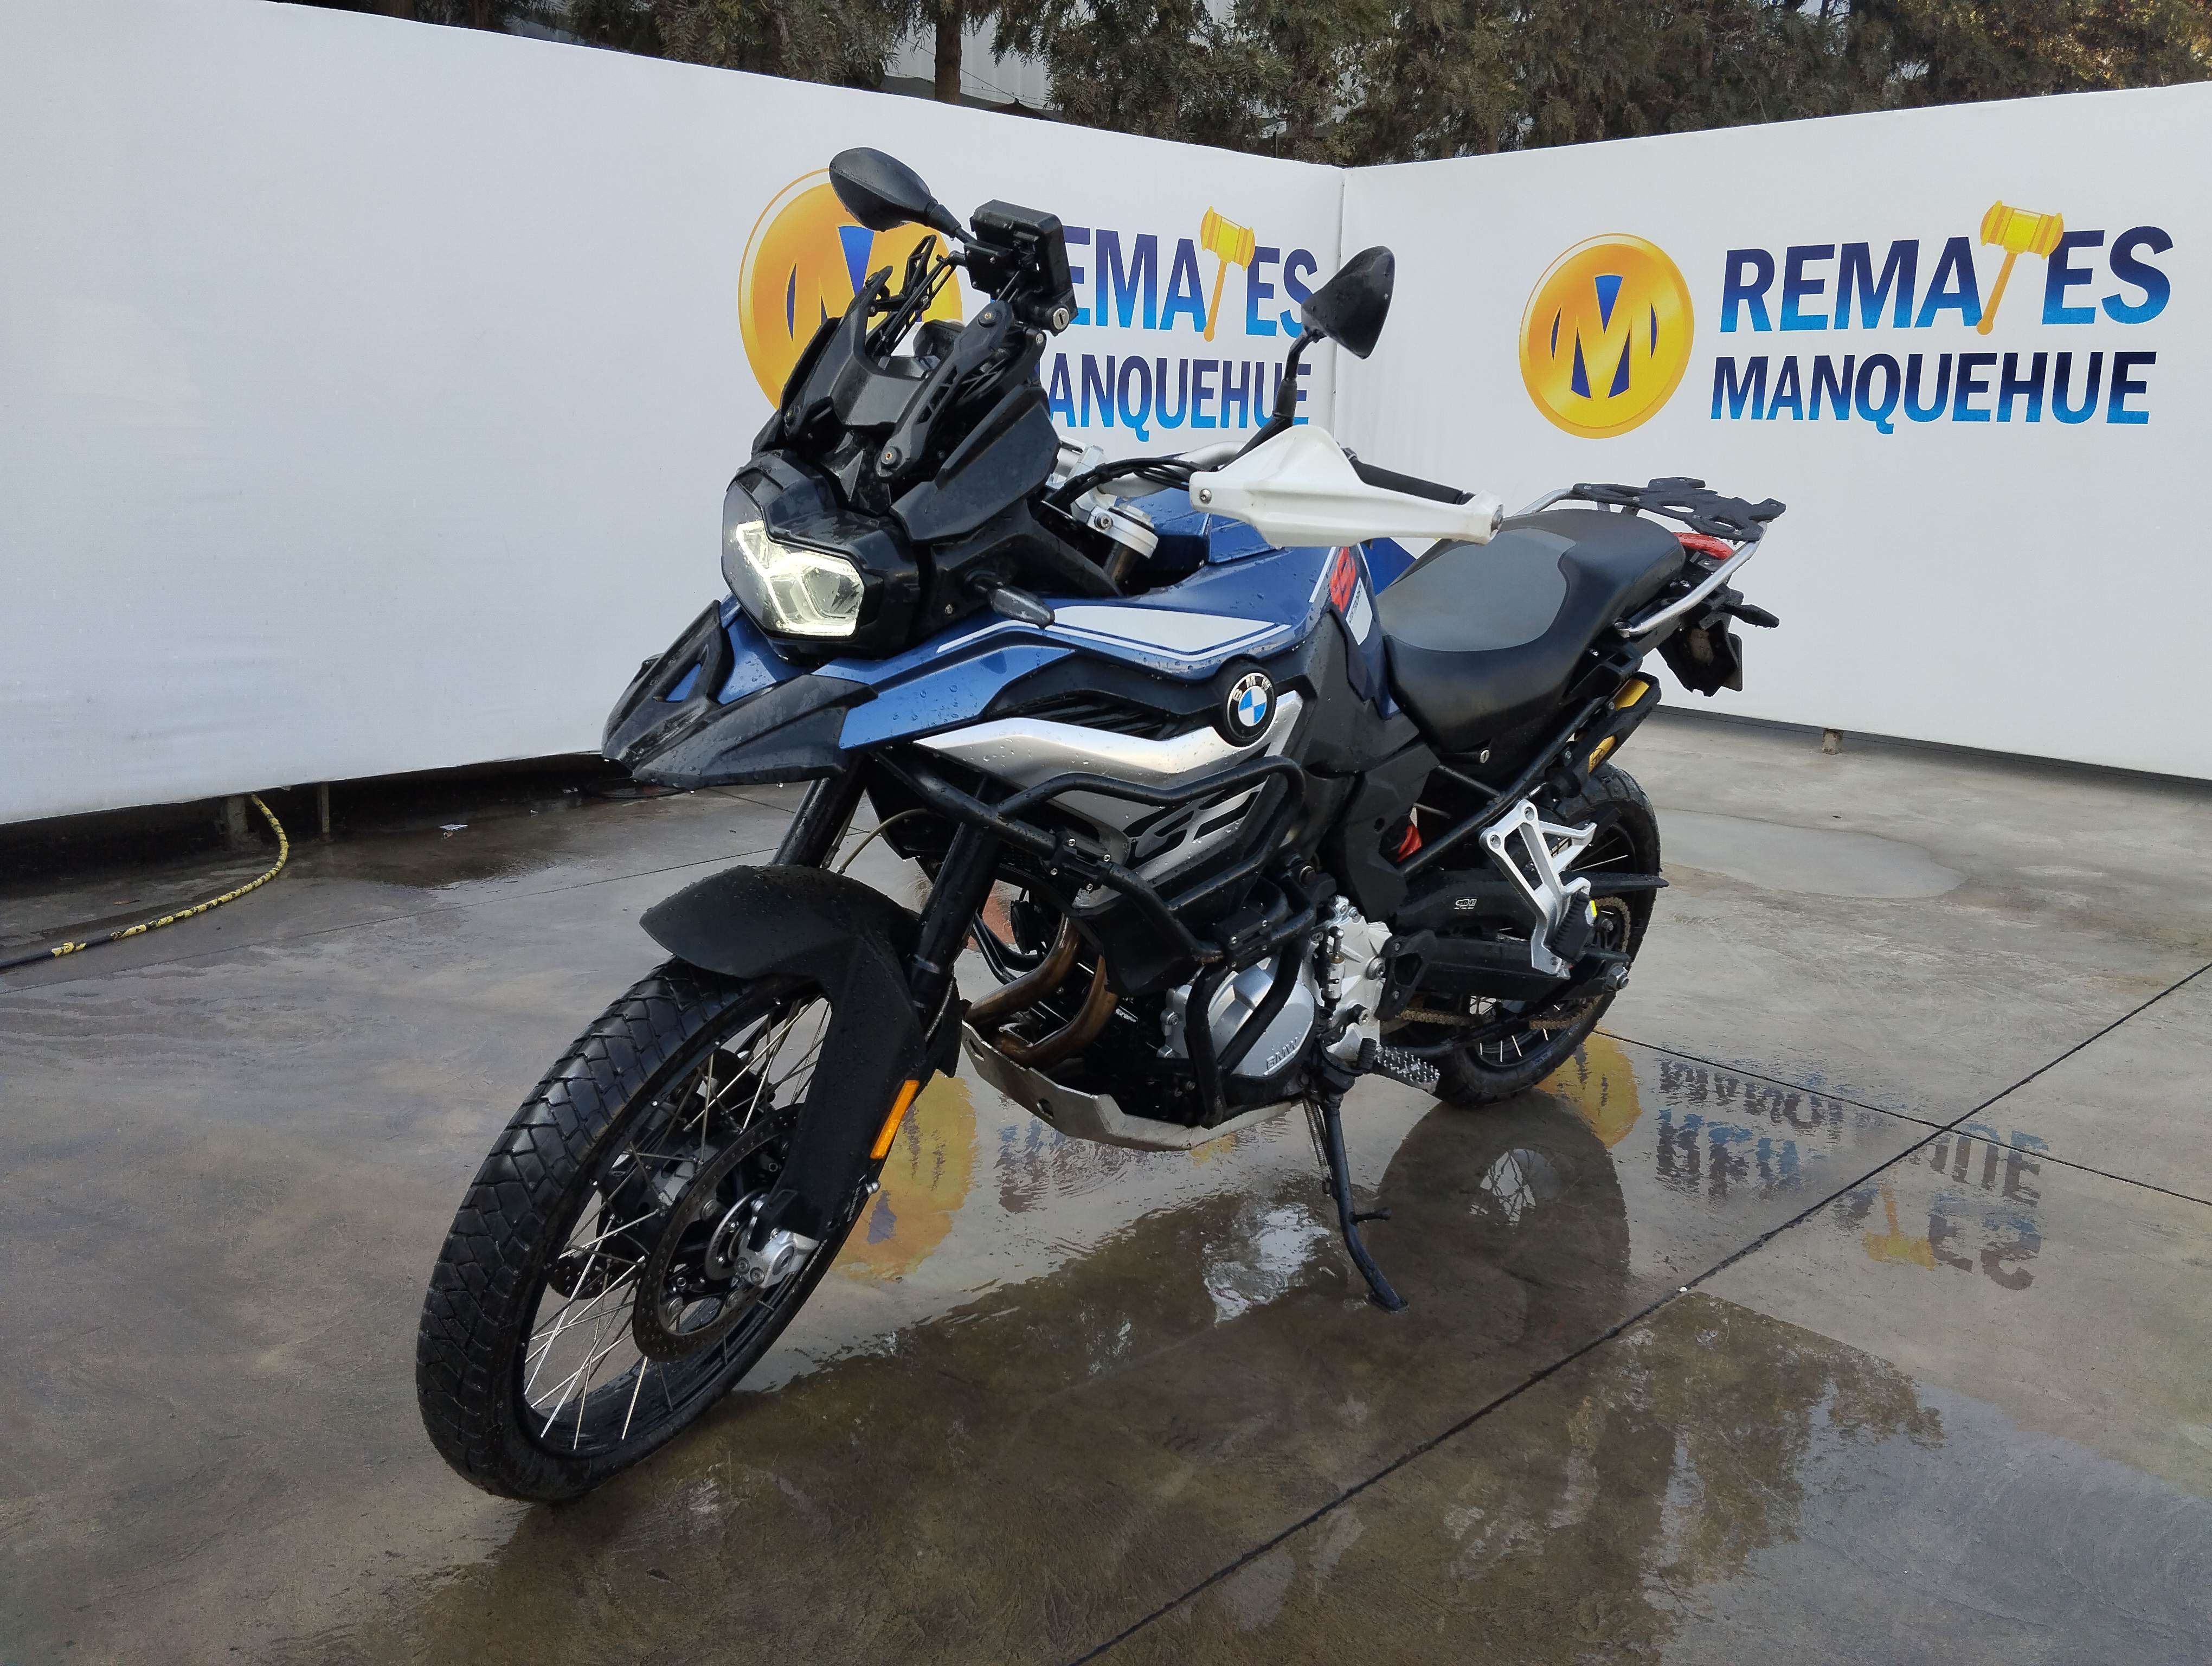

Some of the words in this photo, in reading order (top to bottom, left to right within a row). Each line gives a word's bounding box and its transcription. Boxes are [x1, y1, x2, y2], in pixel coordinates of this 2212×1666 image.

[1720, 202, 2174, 334] REMATES
[1046, 351, 1311, 443] ANQUEHUE
[1711, 351, 2157, 435] MANQUEHUE
[1232, 675, 1272, 702] BMW
[1266, 1036, 1300, 1071] BMW
